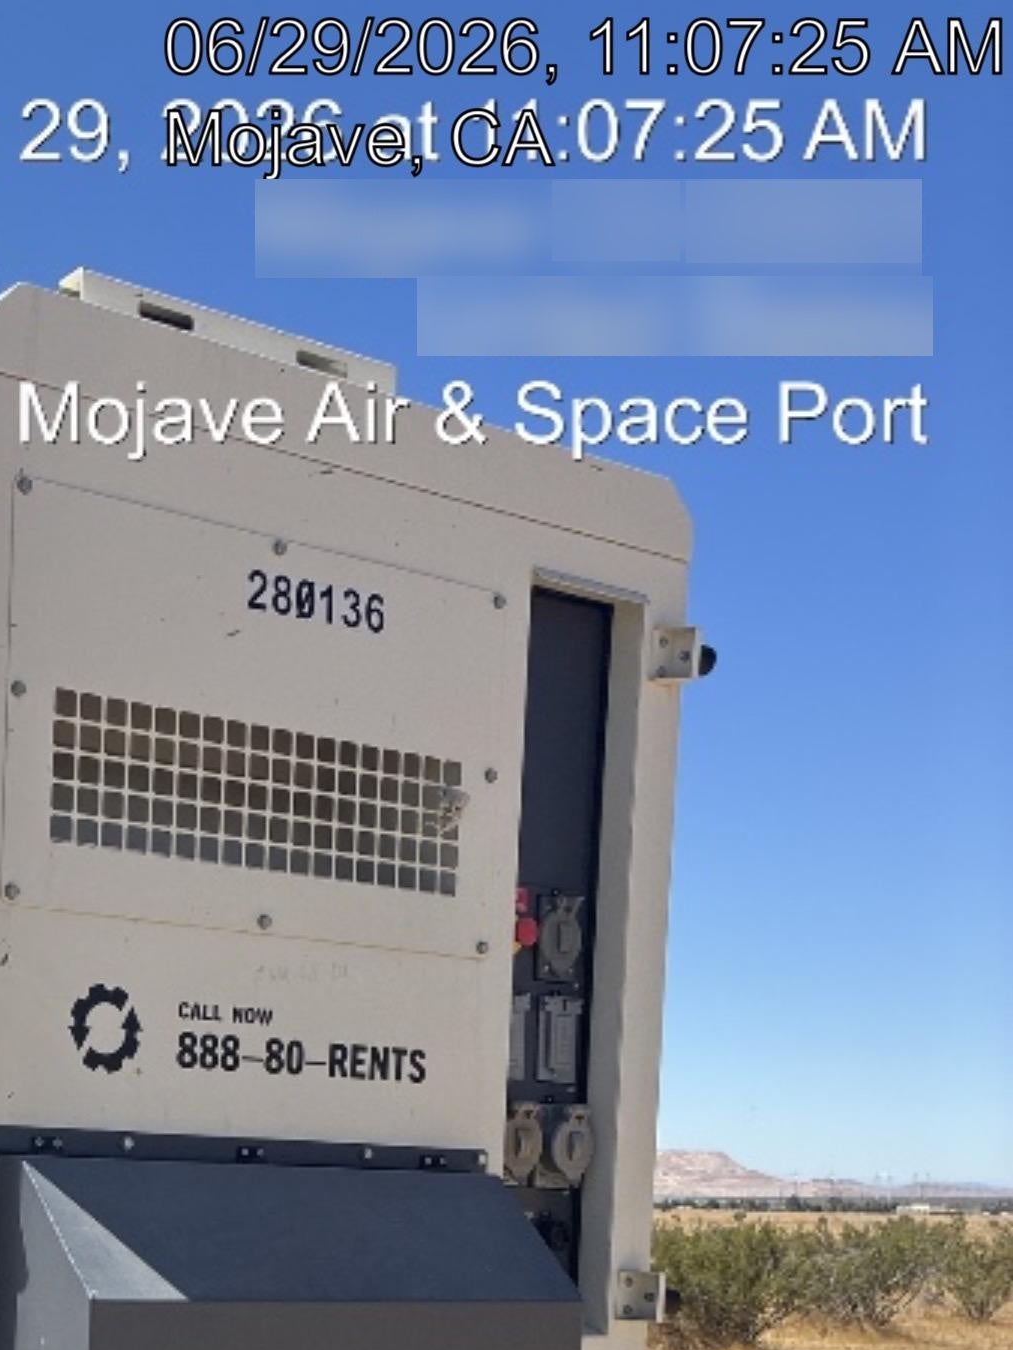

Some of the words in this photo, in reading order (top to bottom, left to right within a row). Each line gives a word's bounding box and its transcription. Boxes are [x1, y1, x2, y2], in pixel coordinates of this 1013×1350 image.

[247, 568, 385, 634] 280136
[177, 1001, 222, 1022] CALL
[233, 1007, 274, 1027] NOW
[176, 1031, 428, 1084] 888-80-RENTS
